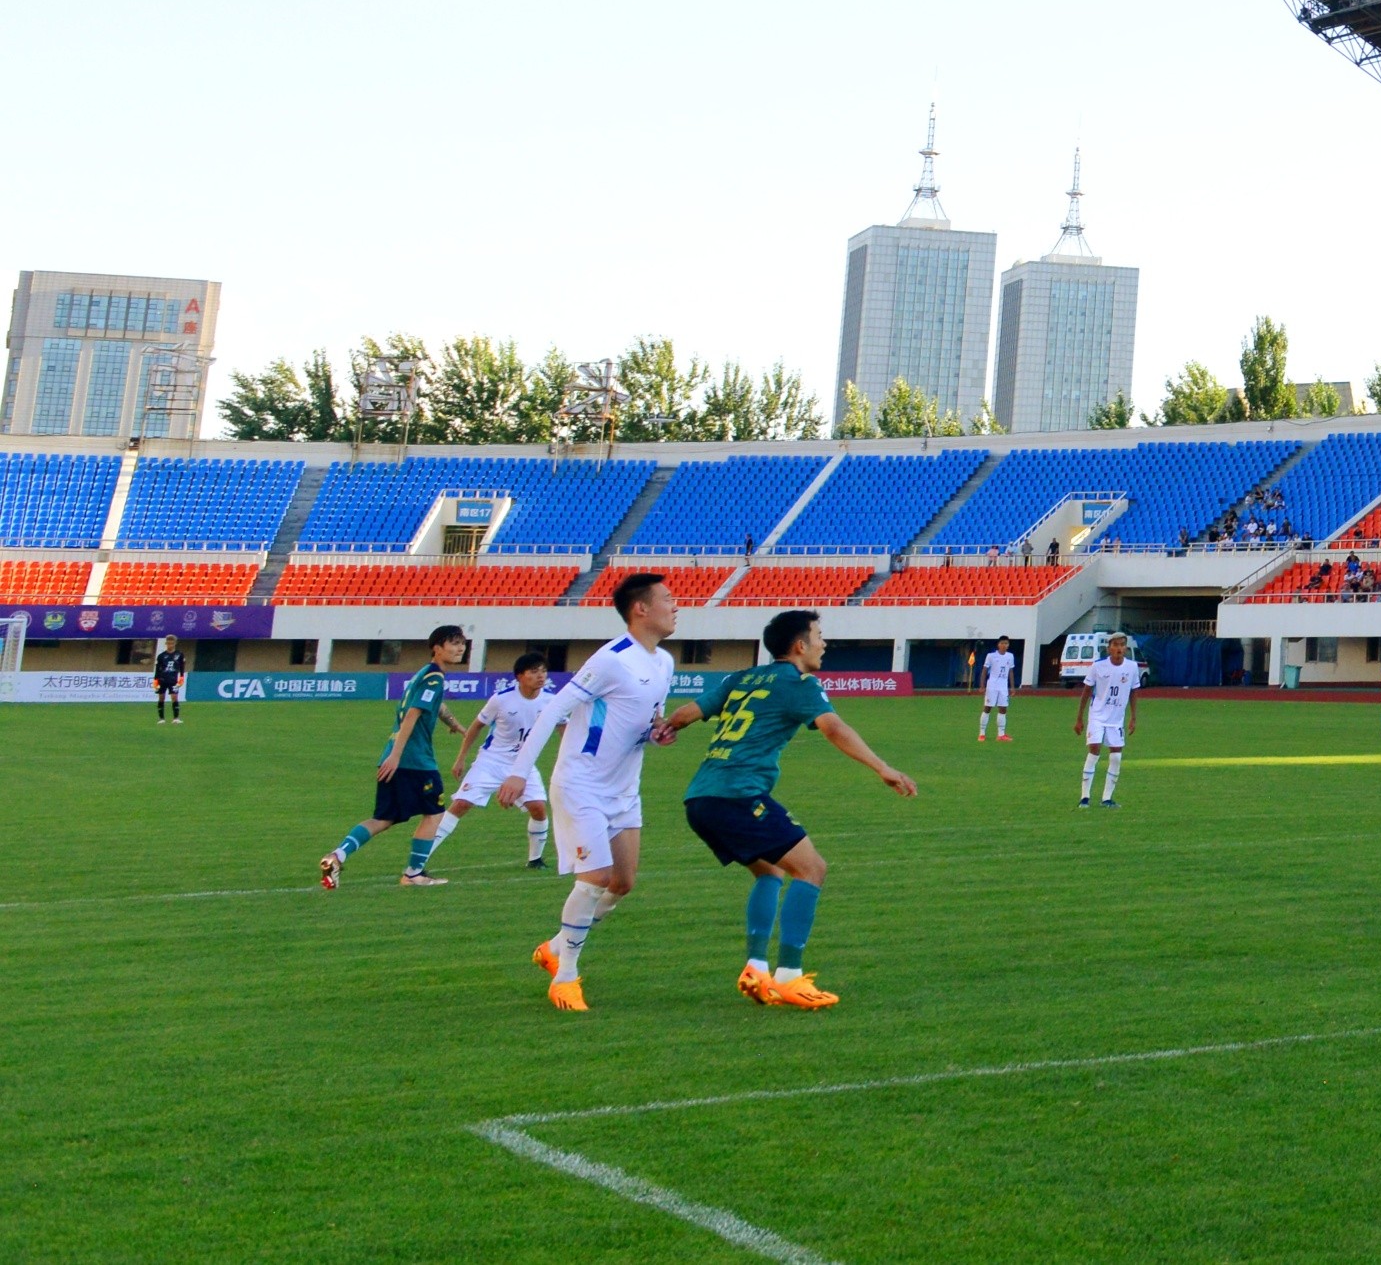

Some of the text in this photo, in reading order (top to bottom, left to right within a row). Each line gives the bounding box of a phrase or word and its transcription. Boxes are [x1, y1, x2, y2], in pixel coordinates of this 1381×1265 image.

[218, 679, 266, 699] CFA
[274, 679, 357, 693] 中国足球协会
[818, 677, 897, 691] 企业体育协会
[1110, 686, 1119, 697] 10
